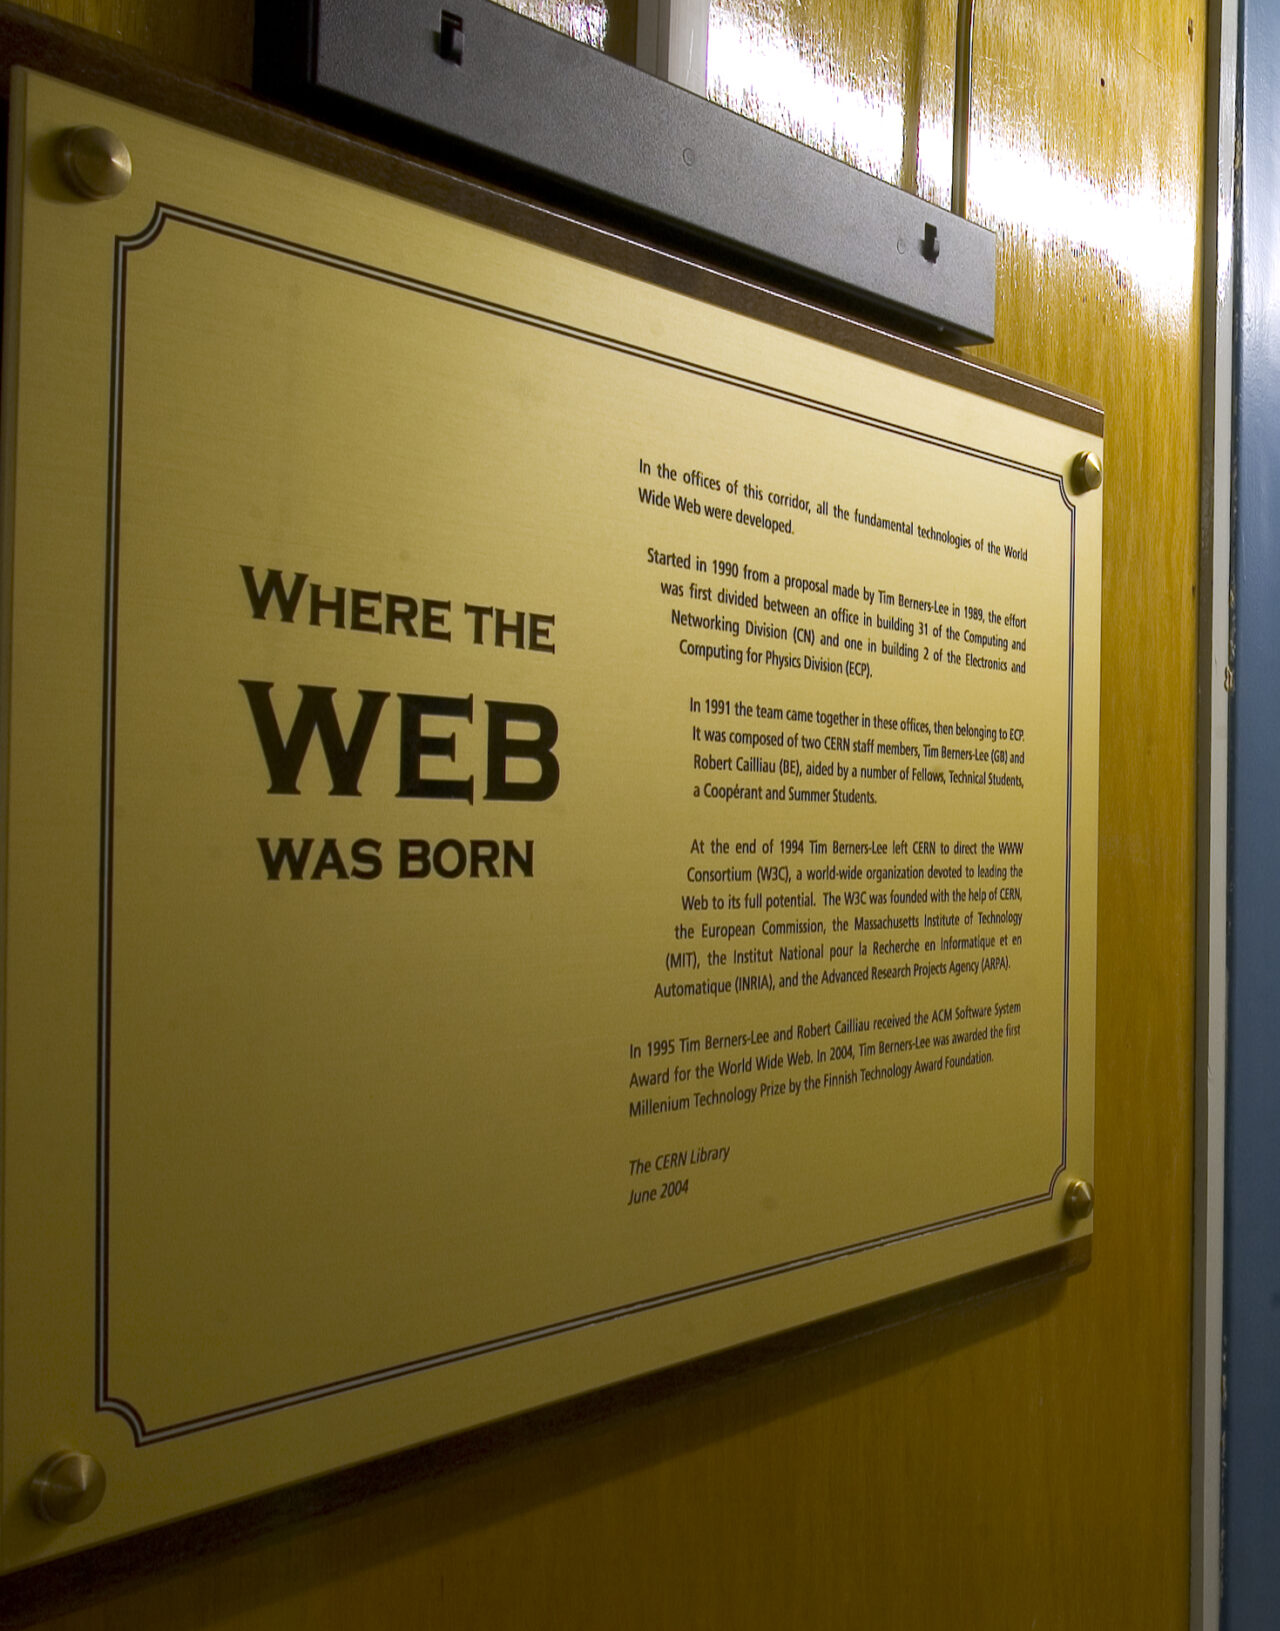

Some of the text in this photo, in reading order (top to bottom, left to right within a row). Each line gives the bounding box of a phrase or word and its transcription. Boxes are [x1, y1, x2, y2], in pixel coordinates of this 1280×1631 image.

[638, 487, 794, 534] Wide Web were developed.
[639, 458, 1028, 562] In the offices of this corridor, all the fundamental technologies of the World
[239, 564, 555, 655] WHERE THE
[647, 547, 1027, 629] Started in 1990 from a proposal made by Tim Berners-Lee in 1989, the effort
[679, 639, 873, 679] Computing for Physics Division (ECP).
[690, 697, 701, 713] In
[705, 698, 730, 715] 1991
[734, 701, 753, 717] the
[756, 704, 783, 720] team
[786, 709, 813, 723] came
[816, 710, 859, 728] together
[861, 713, 871, 728] in
[873, 714, 898, 731] these
[900, 717, 931, 736] offices,
[933, 720, 954, 735] then
[955, 722, 997, 743] belonging
[999, 728, 1008, 740] to
[238, 679, 560, 806] WEB
[693, 782, 877, 804] a Coopérant and Summer Students.
[694, 754, 1024, 789] Robert Cailliau (BE), aided by a number of Fellows, Technical Students,
[256, 837, 534, 881] WAS BORN
[690, 838, 1024, 855] At the end of 1994 Tim Berners-Lee left CERN to direct the WWW
[687, 864, 1023, 884] Consortium (W3C), a world-wide organization devoted to leading the
[674, 910, 1023, 941] the European Commission, the Massachusetts Institute of Technology
[665, 934, 1022, 971] (MIT), the Institut National pour la Recherche en Informatique et en
[654, 955, 1011, 999] Automatique (INRIA), and the Advanced Research Projects Agency (ARPA).
[630, 1002, 1021, 1059] In 1995 Tim Berners-Lee and Robert Cailliau received the ACM Software System
[629, 1096, 690, 1117] Millenium
[693, 1086, 757, 1107] Technology
[760, 1083, 786, 1098] Prize
[789, 1078, 801, 1096] by
[803, 1075, 821, 1091] the
[823, 1069, 858, 1088] Finnish
[860, 1063, 912, 1082] Technology
[914, 1056, 943, 1074] Award
[629, 1146, 730, 1176] The CERN Library
[627, 1179, 689, 1206] June 2004
